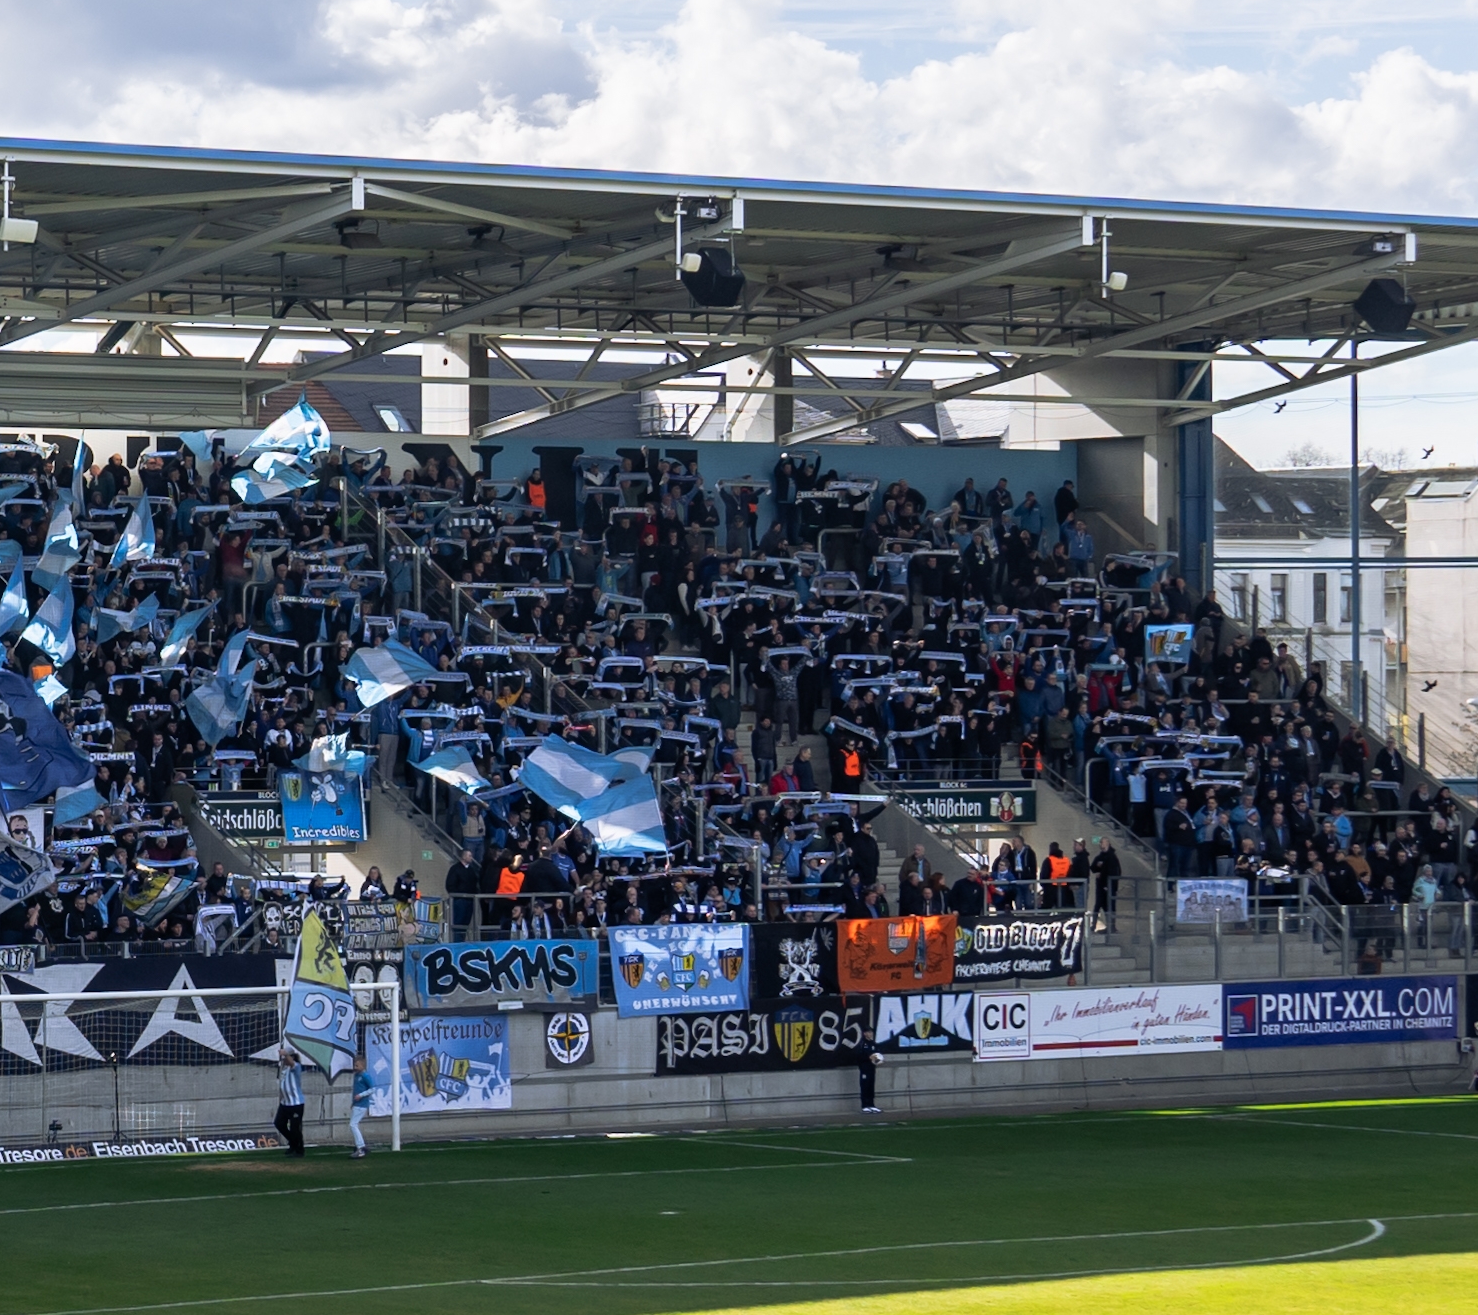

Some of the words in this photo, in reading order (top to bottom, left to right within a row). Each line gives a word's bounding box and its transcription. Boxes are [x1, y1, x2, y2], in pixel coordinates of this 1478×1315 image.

[292, 825, 361, 839] Incredibles
[974, 928, 1004, 954] OLD
[1009, 923, 1059, 951] BLOCK
[422, 944, 577, 997] BSKMS
[1013, 959, 1052, 974] CHEMNITZ
[633, 995, 739, 1011] UNERWÜNSCHT
[1071, 989, 1160, 1021] Immobilienverkauf
[1261, 986, 1453, 1024] PRINT-XXL.COM
[983, 1002, 1027, 1032] CIC
[1261, 1024, 1281, 1036] DER
[1380, 1019, 1391, 1030] IN
[1392, 1016, 1453, 1031] CHEMNITZ
[981, 1038, 1028, 1048] Immobilien
[1140, 1034, 1213, 1046] cic-immobilien.com
[92, 1141, 187, 1158] Eisenbach
[188, 1136, 256, 1152] Tresore
